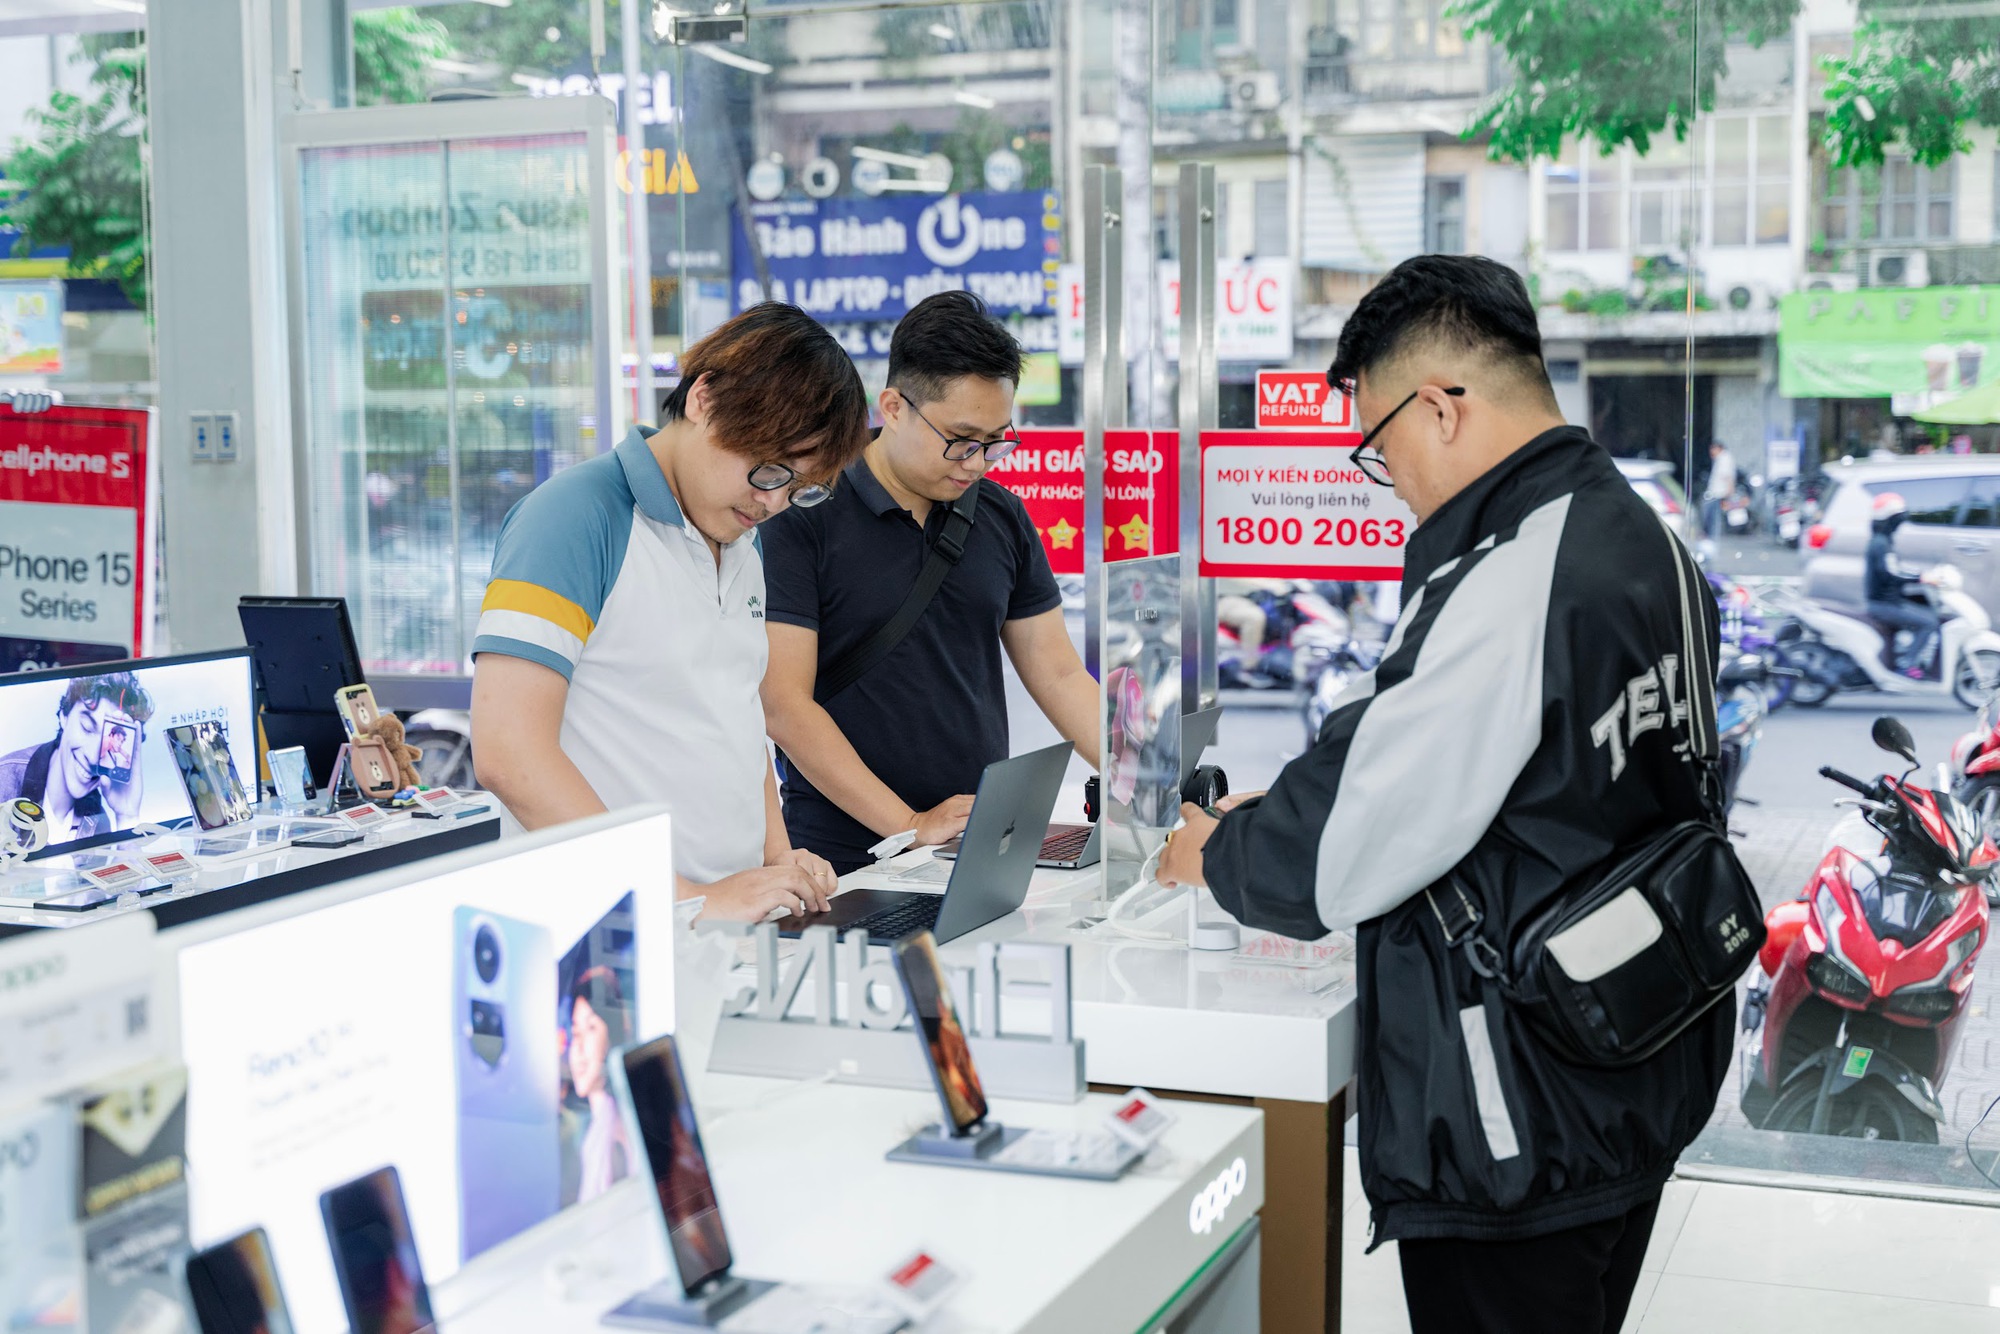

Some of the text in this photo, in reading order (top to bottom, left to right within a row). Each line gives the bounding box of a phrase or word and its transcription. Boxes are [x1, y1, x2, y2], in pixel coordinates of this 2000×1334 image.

[1261, 383, 1321, 404] VAT
[1261, 404, 1321, 417] REFUND
[1045, 444, 1085, 473] GIÁ
[1112, 449, 1163, 473] SAO
[1217, 469, 1249, 486] MỌI
[1254, 465, 1265, 483] Ý
[1269, 463, 1308, 484] KIẾN
[1314, 466, 1364, 484] ĐÓNG
[1010, 483, 1042, 500] QUÝ
[1118, 484, 1155, 500] LÒNG
[1252, 491, 1371, 509] Vui lòng liên hệ
[1217, 516, 1405, 547] 1800 2063
[97, 551, 131, 587] 15
[20, 588, 97, 623] Series
[1724, 927, 1750, 954] 2010
[1189, 1157, 1247, 1234] oppo
